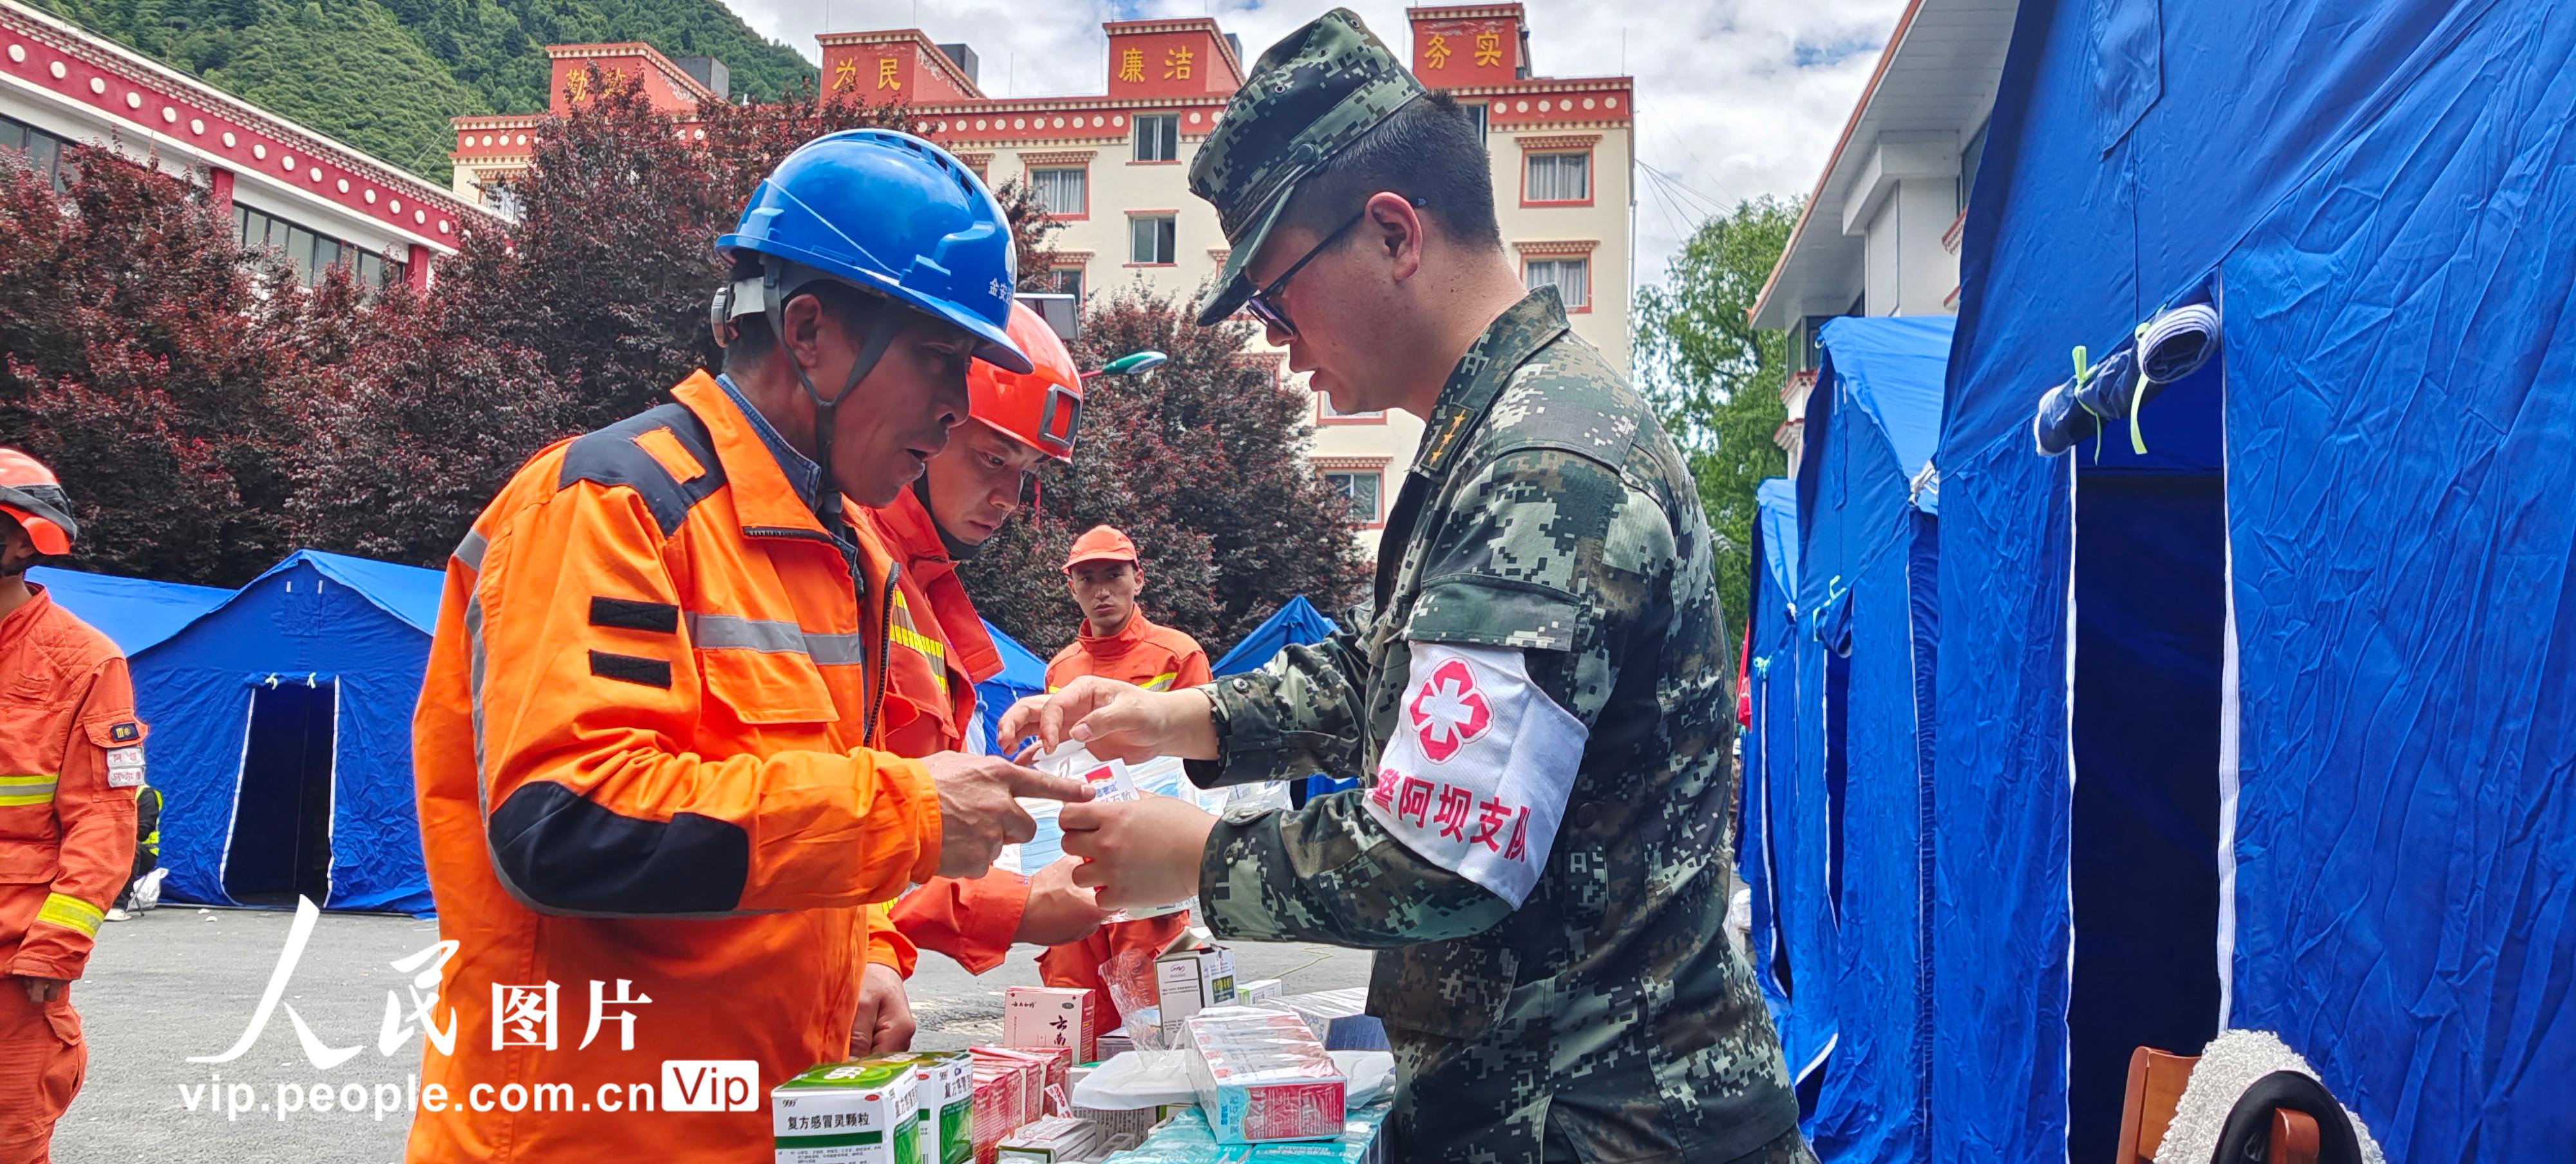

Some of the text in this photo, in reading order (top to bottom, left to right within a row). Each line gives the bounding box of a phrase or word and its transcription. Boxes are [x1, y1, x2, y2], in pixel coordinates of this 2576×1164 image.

[1118, 46, 1193, 82] 廉洁
[1424, 31, 1503, 69] 务实
[832, 58, 902, 91] 为民
[788, 1112, 870, 1131] 复方感冒灵颗粒
